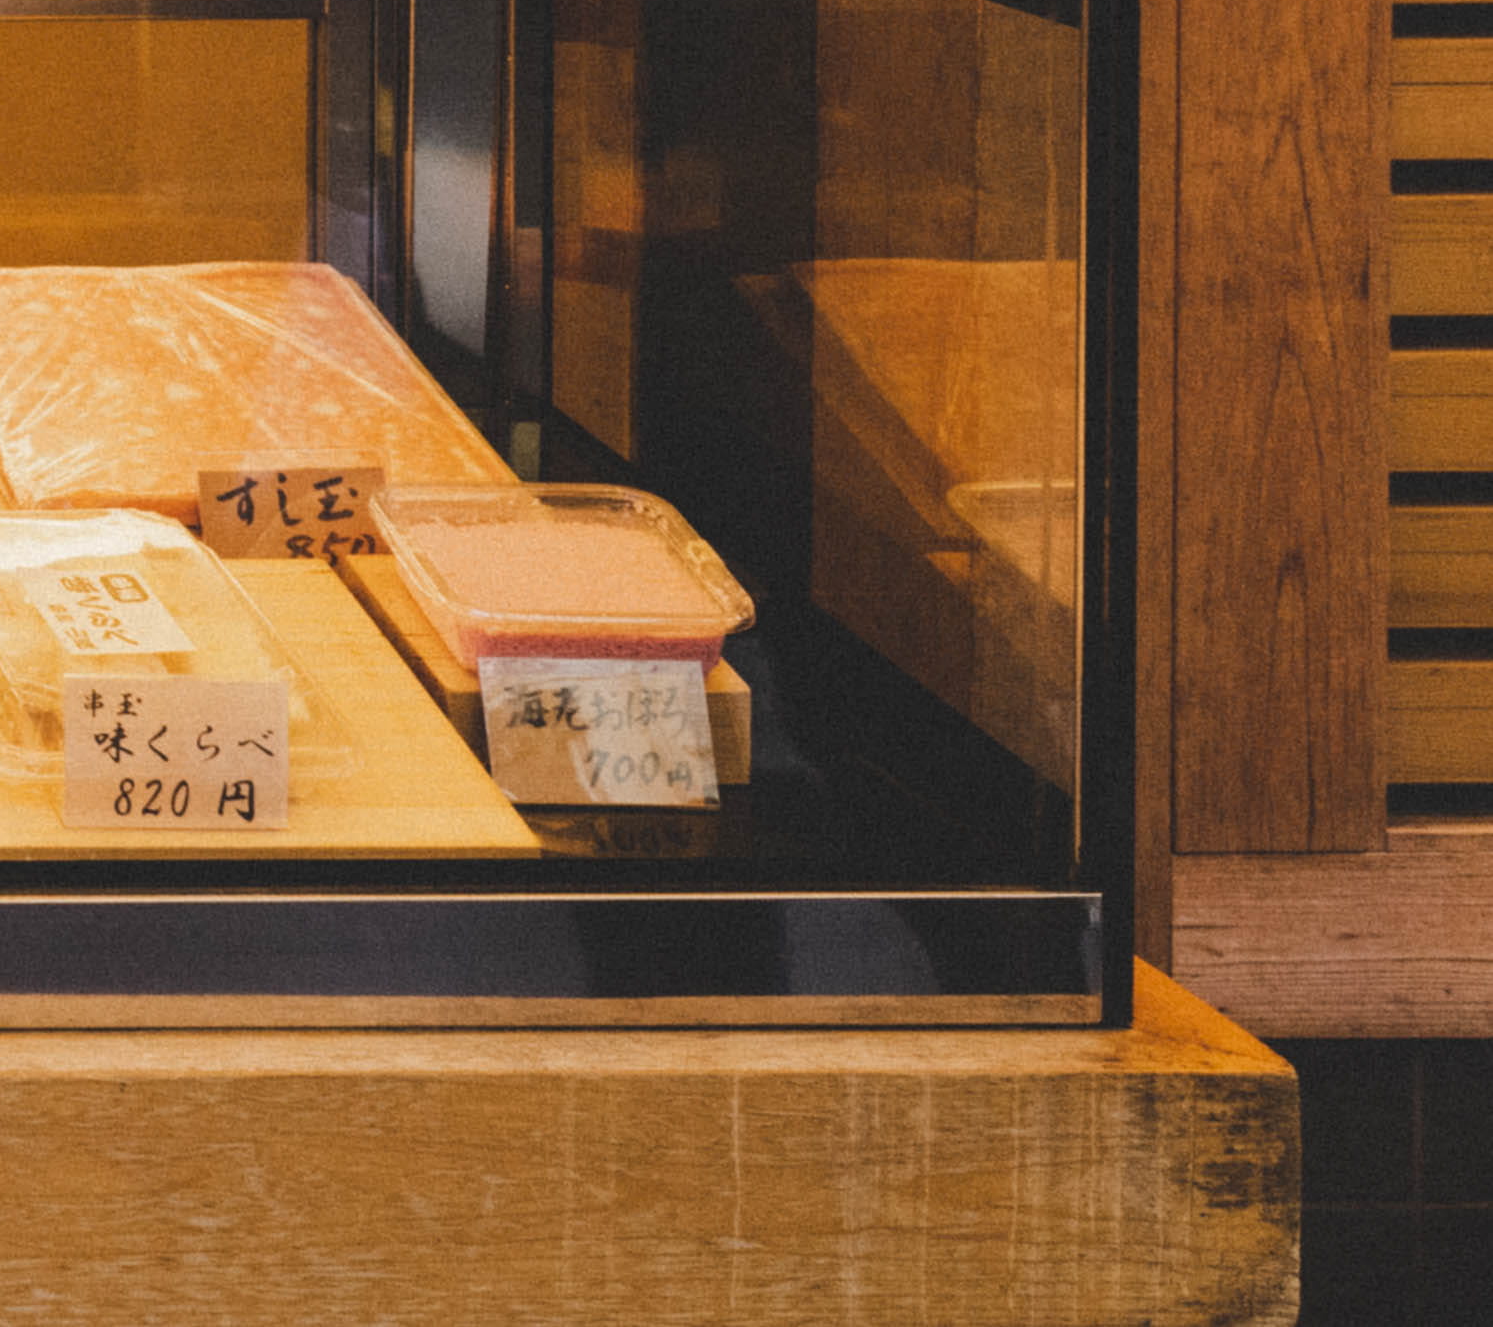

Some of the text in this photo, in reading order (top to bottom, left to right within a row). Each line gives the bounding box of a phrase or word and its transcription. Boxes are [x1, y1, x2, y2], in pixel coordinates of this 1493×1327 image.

[216, 472, 358, 527] すし玉
[93, 723, 274, 763] 味くらべ
[114, 778, 255, 822] 820円
